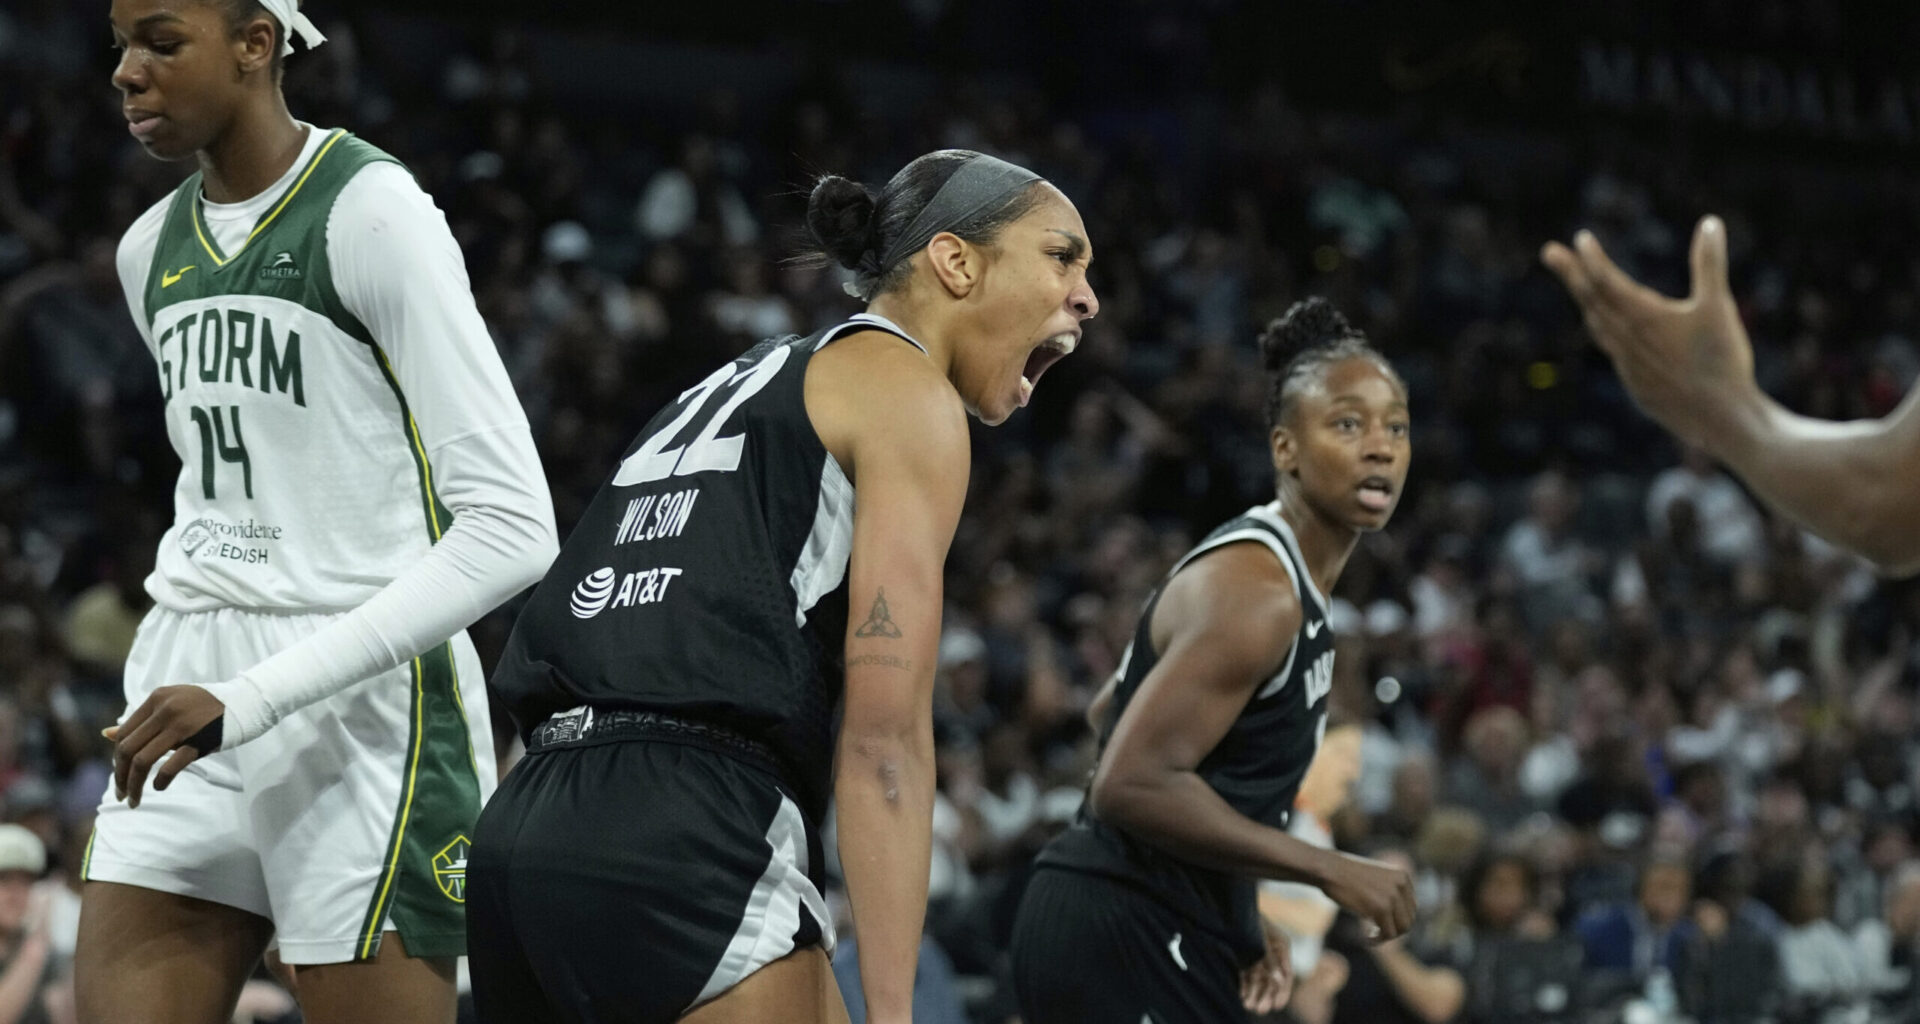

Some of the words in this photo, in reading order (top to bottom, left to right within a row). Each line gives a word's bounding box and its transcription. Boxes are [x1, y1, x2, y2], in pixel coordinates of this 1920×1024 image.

[1579, 43, 1920, 139] MANDALA
[159, 308, 307, 408] STORM
[190, 405, 254, 500] 14
[612, 344, 791, 487] 22
[614, 488, 699, 546] WILSON
[611, 566, 683, 609] AT&T
[847, 654, 912, 672] MPOSSIBLE
